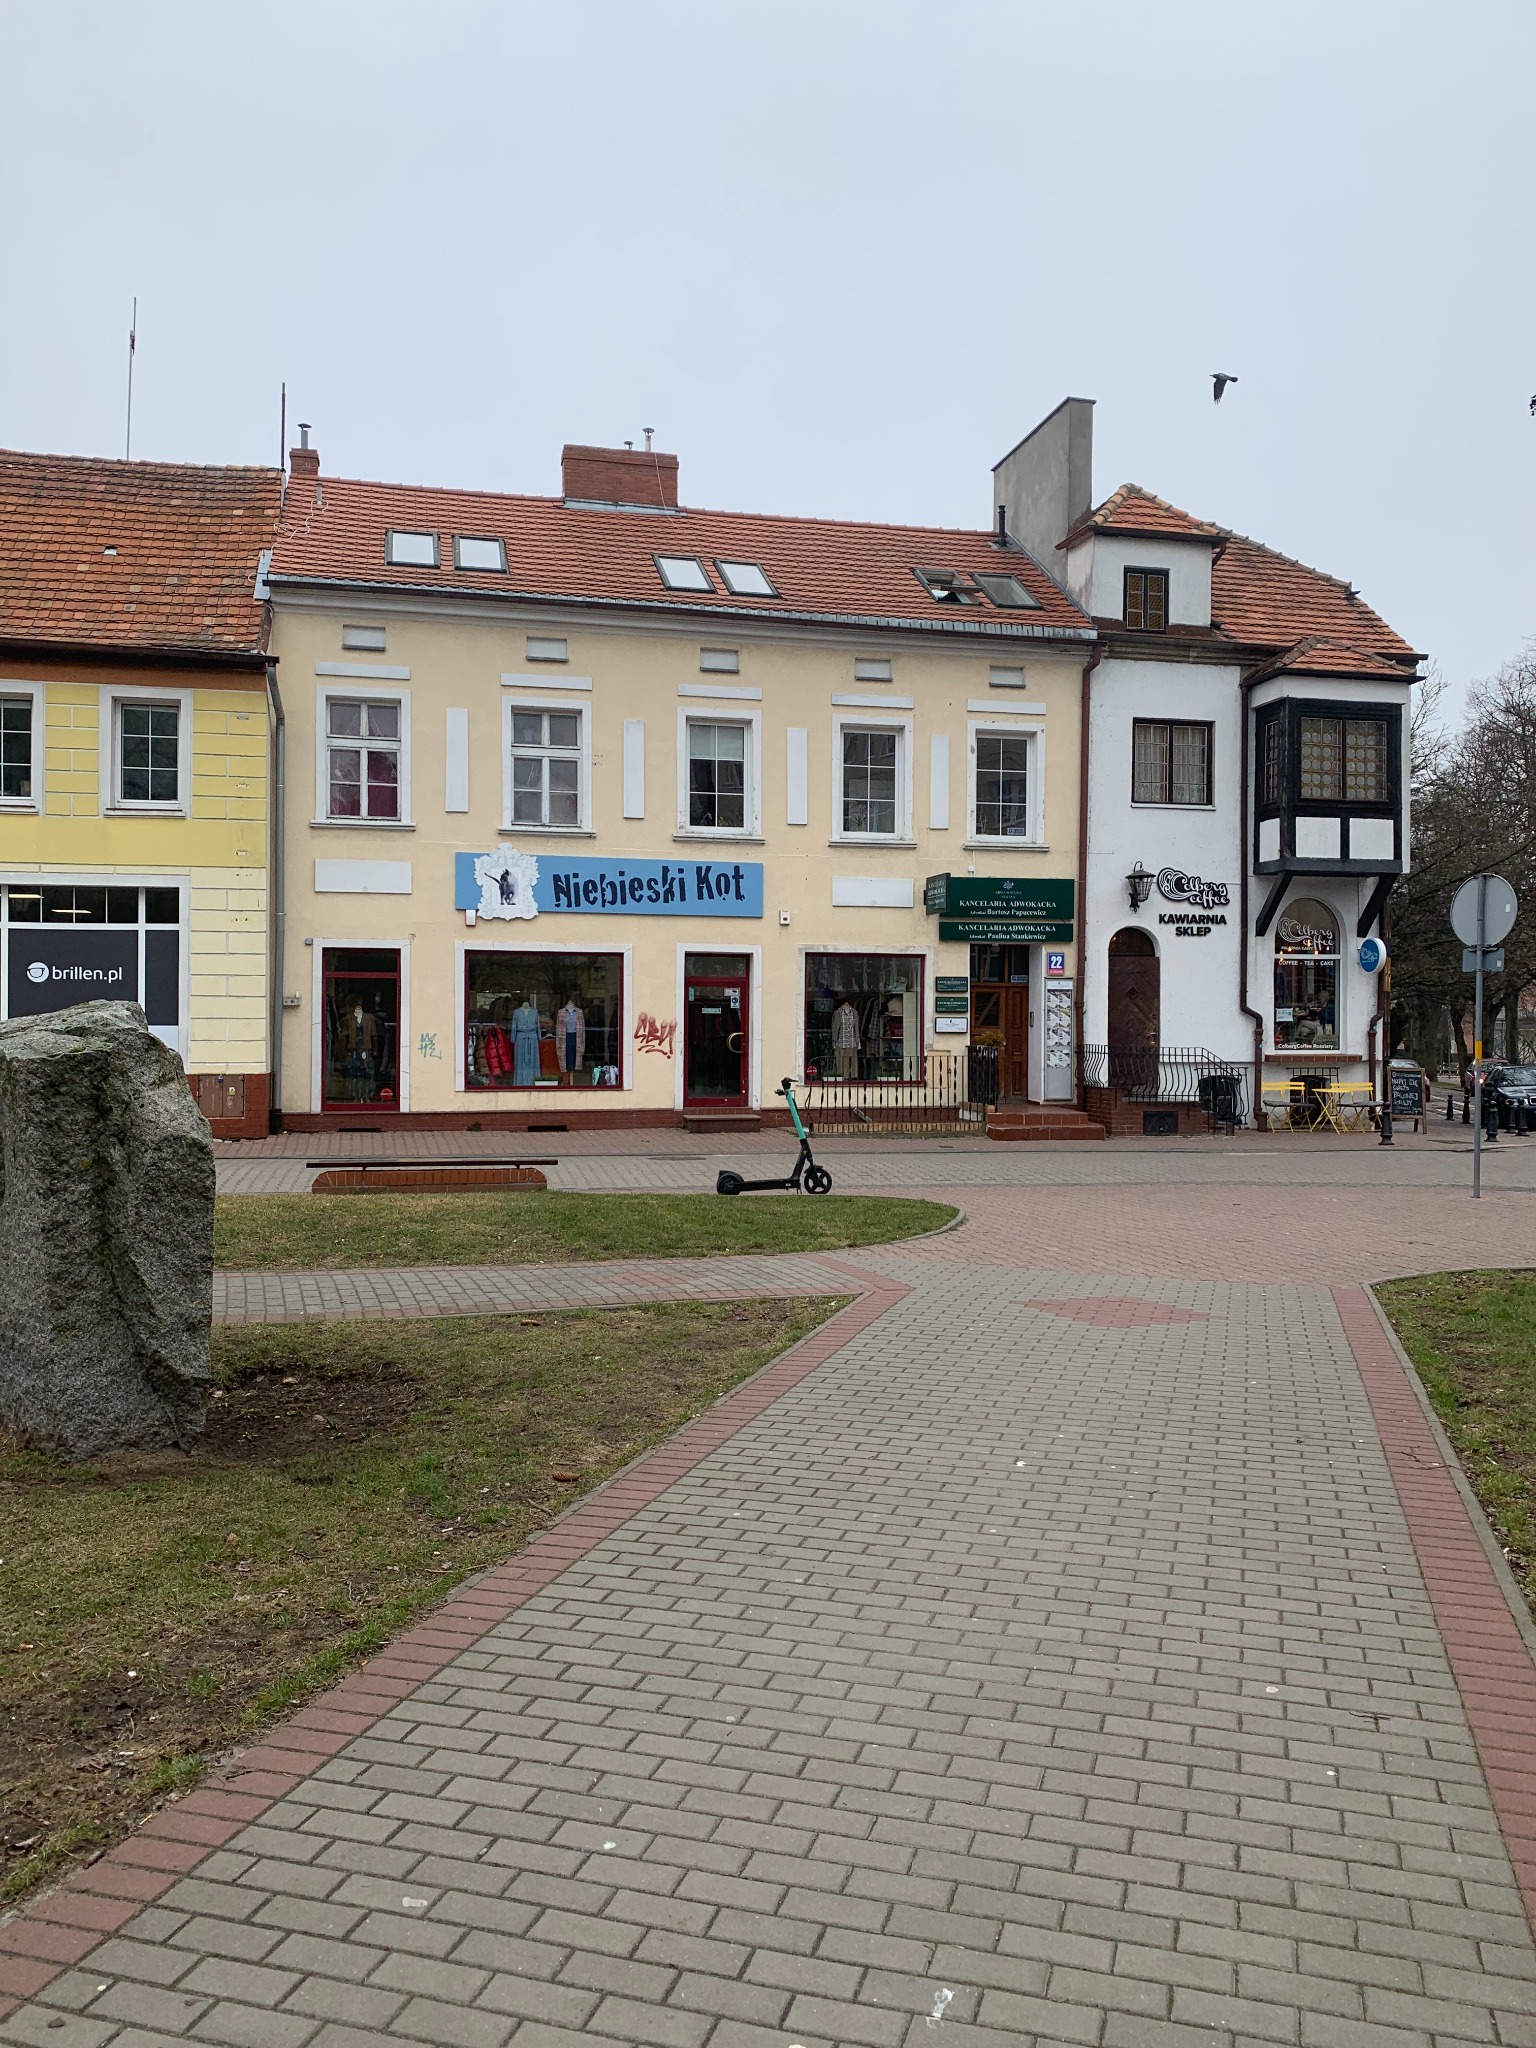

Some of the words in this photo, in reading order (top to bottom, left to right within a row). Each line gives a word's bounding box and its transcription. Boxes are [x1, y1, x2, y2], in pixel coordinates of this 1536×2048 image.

[553, 866, 687, 908] Niebieski
[696, 865, 746, 901] Kot
[1164, 870, 1228, 899] Colberg
[1008, 900, 1057, 908] ADWOKACKA
[1190, 891, 1230, 908] coffee
[1011, 909, 1047, 917] Papucewicz
[1158, 914, 1227, 925] KAWIARNIA
[958, 924, 1007, 932] KANCELARIA
[1008, 924, 1057, 932] ADWOKACKA
[1175, 926, 1212, 937] SKLEP
[1011, 932, 1047, 940] Stankiewicz
[1050, 955, 1063, 969] 22
[52, 966, 123, 984] brillen.pl
